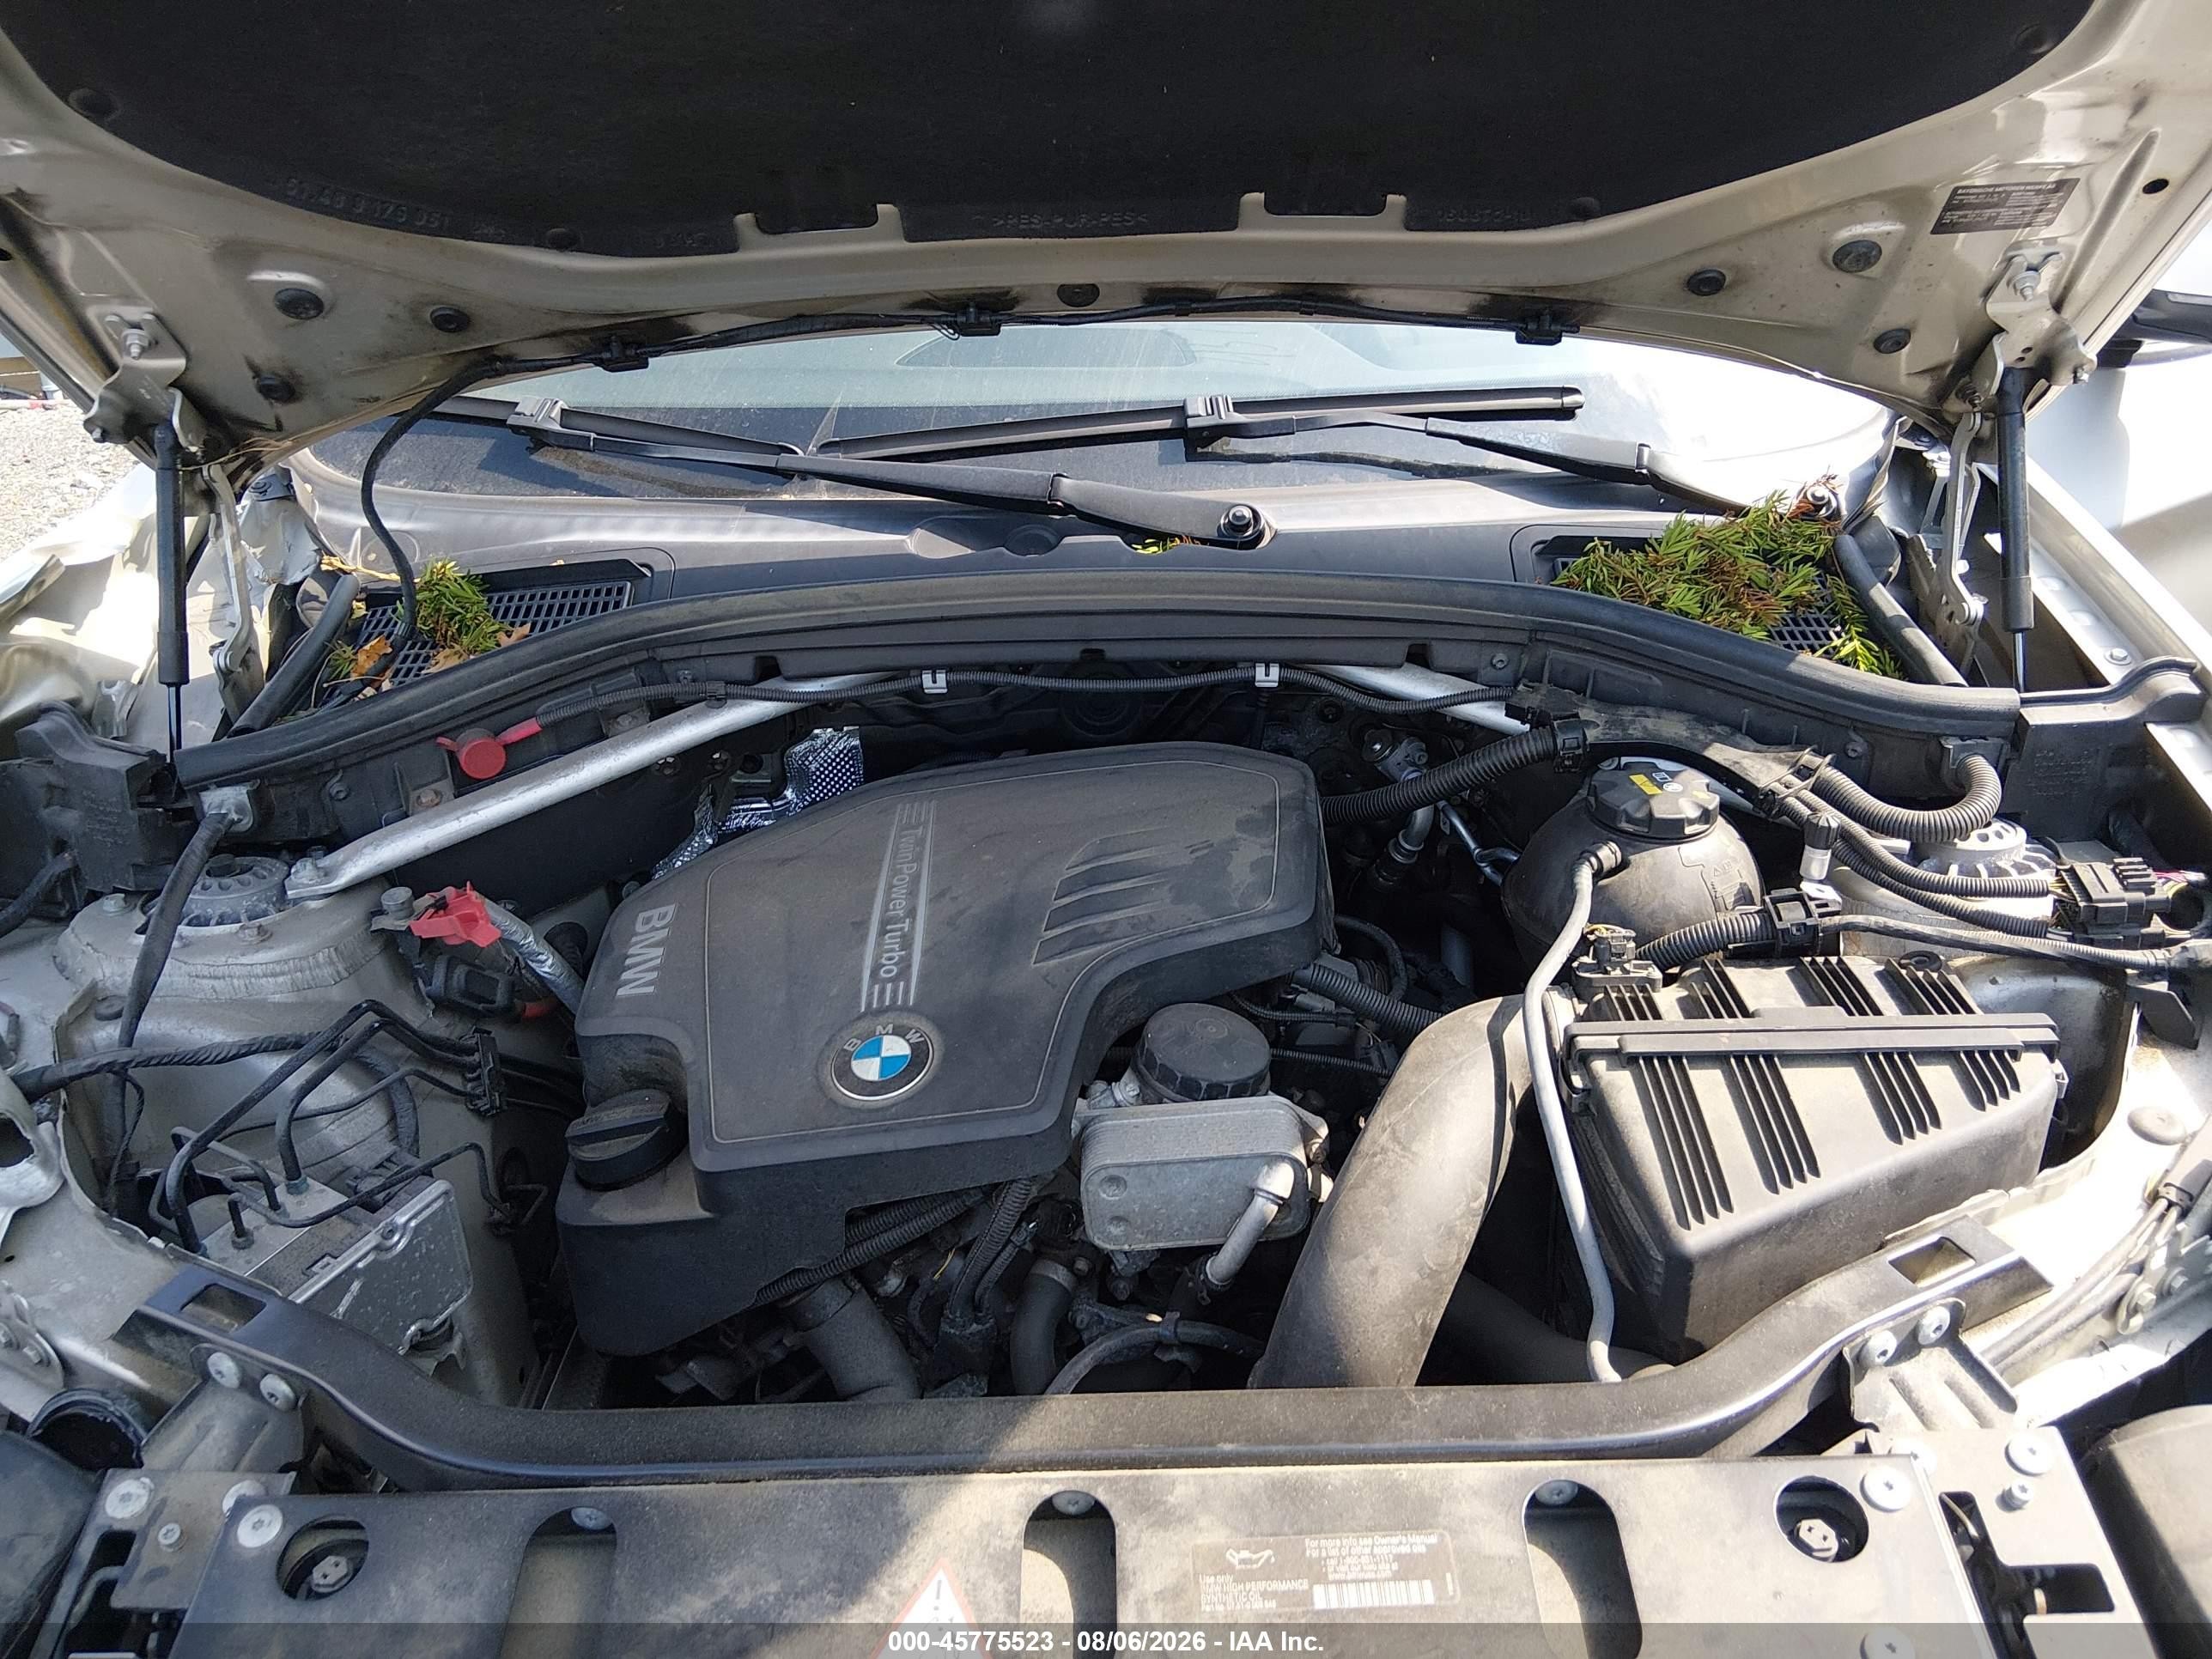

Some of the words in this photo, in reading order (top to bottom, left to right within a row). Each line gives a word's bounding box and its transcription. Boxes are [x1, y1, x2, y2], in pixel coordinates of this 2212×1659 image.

[616, 902, 677, 996] BMW
[880, 917, 909, 978] Turbo
[842, 1022, 926, 1054] BMW
[1305, 1538, 1319, 1548] For
[1320, 1537, 1341, 1547] more
[1341, 1535, 1358, 1547] info
[1373, 1534, 1407, 1545] Owner's
[1407, 1533, 1438, 1544] Manual
[1306, 1547, 1320, 1558] For
[1340, 1546, 1350, 1555] of
[1373, 1545, 1411, 1555] approved
[1199, 1573, 1215, 1583] Use
[1216, 1572, 1234, 1584] only
[1223, 1581, 1245, 1593] HIGH
[1245, 1577, 1310, 1592] PERFORMANCE
[1200, 1591, 1249, 1603] SYNTHETIC
[1249, 1590, 1263, 1601] OIL
